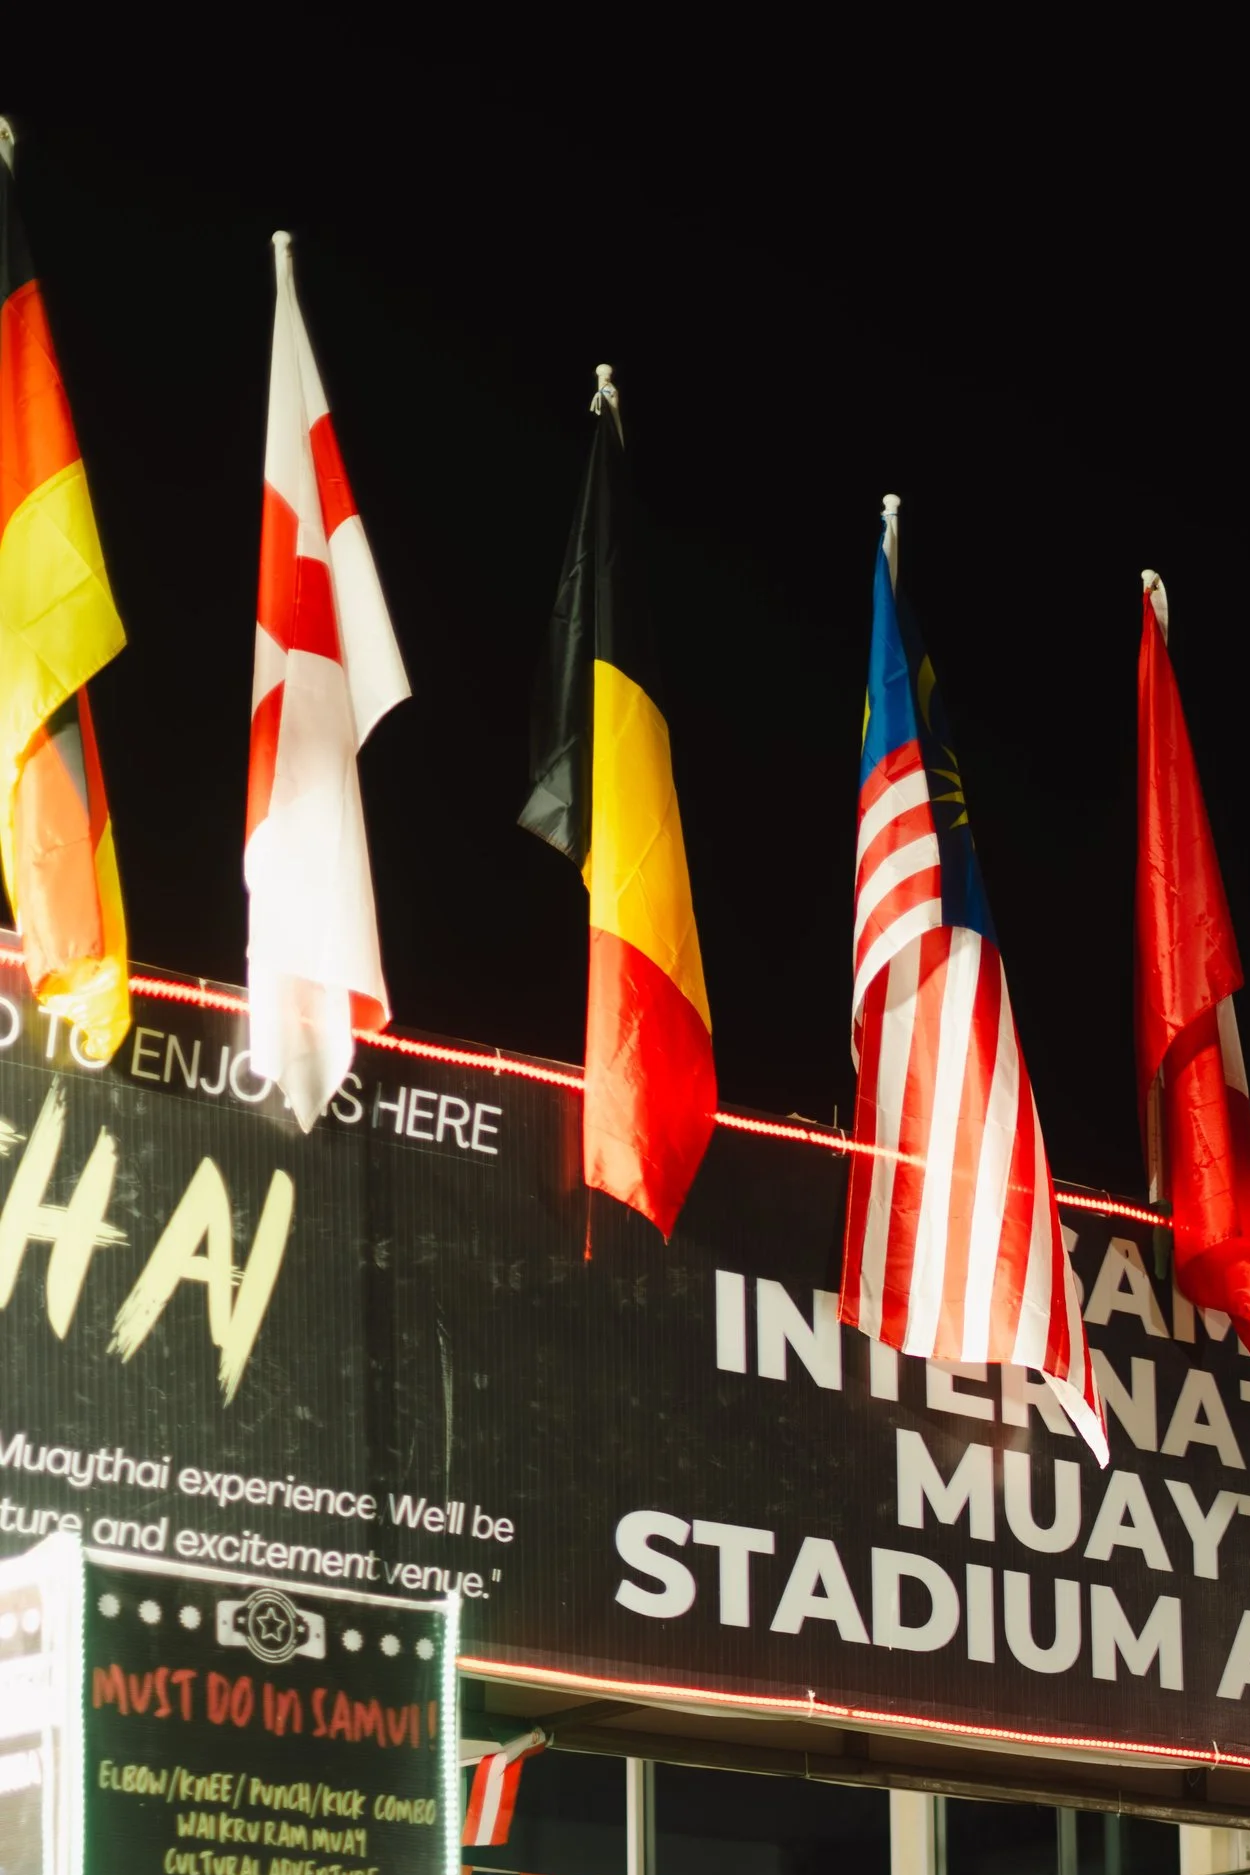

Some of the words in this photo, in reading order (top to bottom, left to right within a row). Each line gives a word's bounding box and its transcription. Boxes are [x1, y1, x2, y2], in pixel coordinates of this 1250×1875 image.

[371, 1080, 503, 1155] HERE
[0, 1072, 296, 1408] HAI
[0, 1505, 82, 1536] ture
[92, 1517, 168, 1553] and
[175, 1529, 381, 1583] excitement
[389, 1492, 464, 1535] We'll
[472, 1503, 515, 1543] be
[614, 1509, 1184, 1692] STADIUM
[92, 1663, 199, 1721] MUST
[206, 1670, 254, 1728] DO
[219, 1813, 261, 1845] KRU
[263, 1820, 309, 1850] RAM
[311, 1827, 368, 1858] MUAY
[373, 1794, 437, 1826] COMBO
